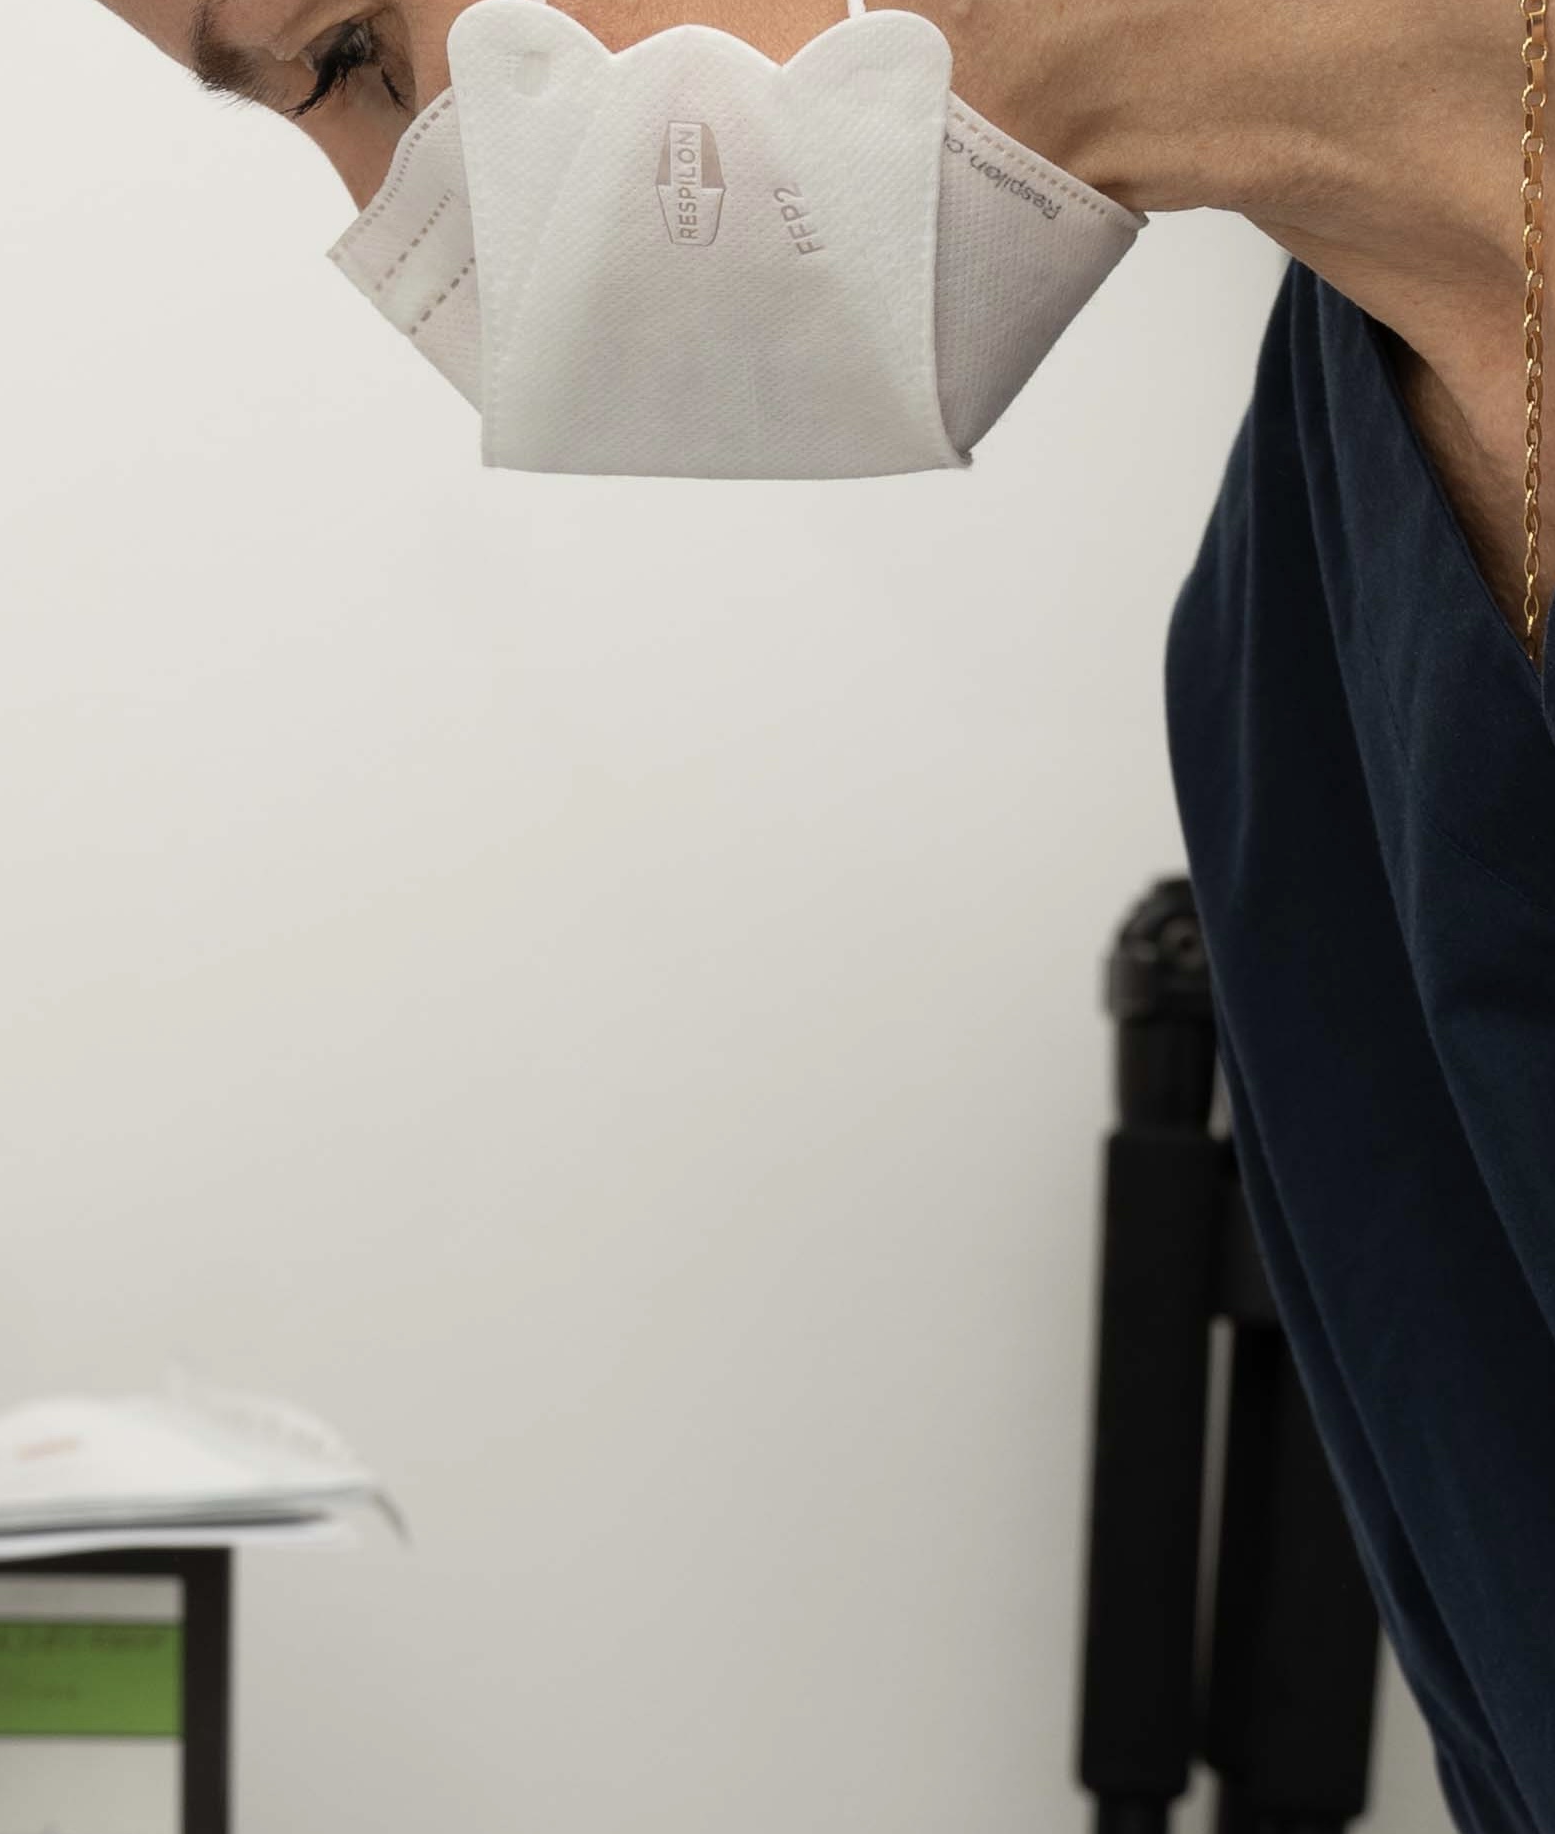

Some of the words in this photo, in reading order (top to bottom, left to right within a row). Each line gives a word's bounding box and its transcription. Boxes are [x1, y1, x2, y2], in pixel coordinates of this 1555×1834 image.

[677, 130, 699, 240] RESPILON
[774, 180, 825, 255] FFP2
[943, 133, 1062, 220] Respilon.c
